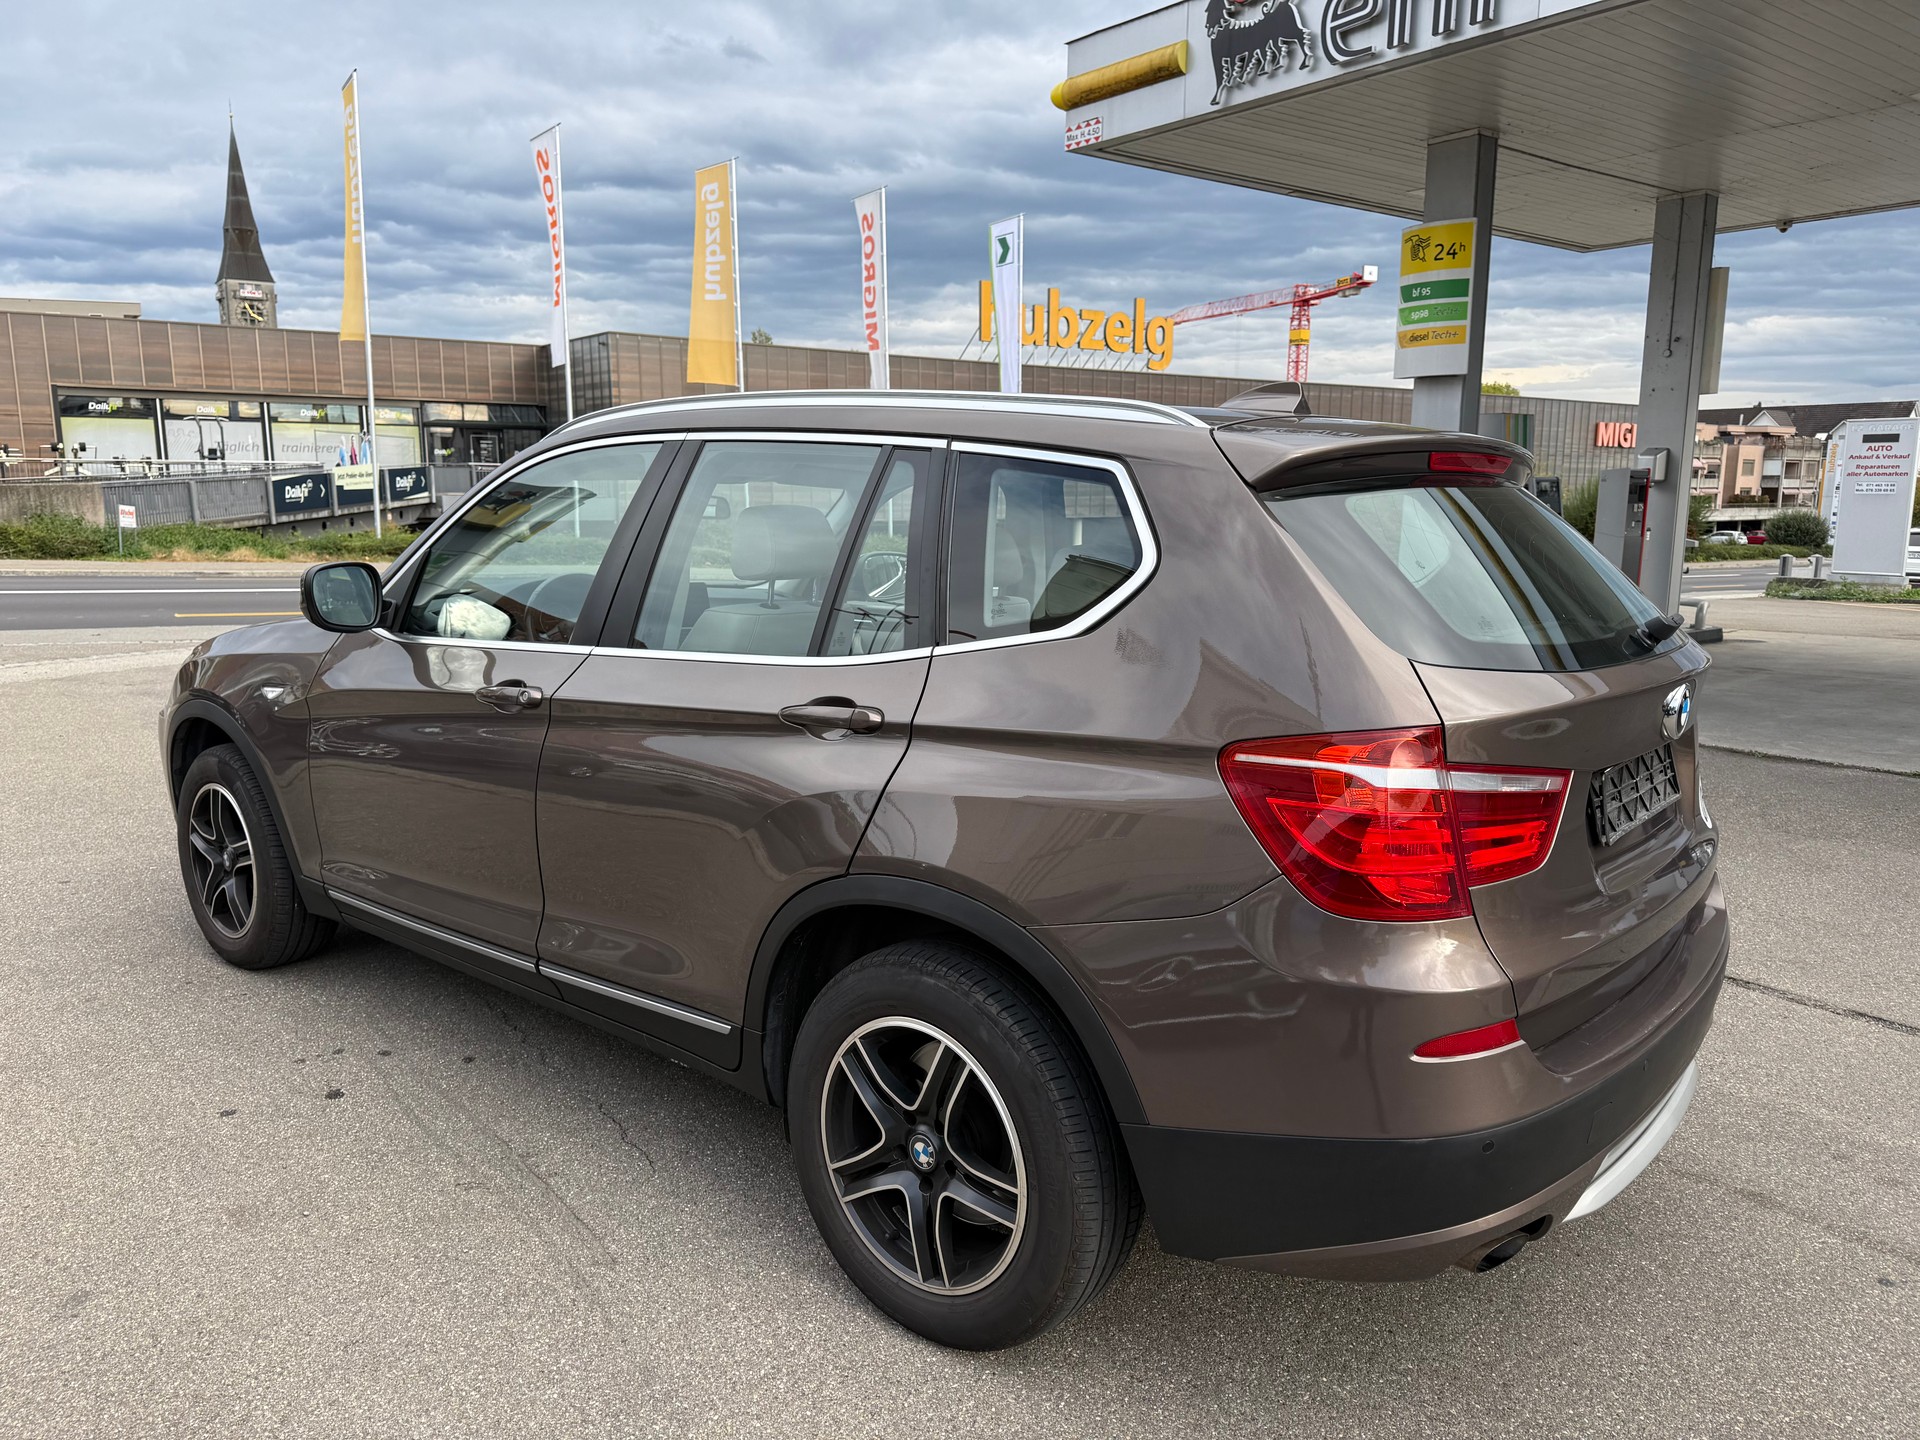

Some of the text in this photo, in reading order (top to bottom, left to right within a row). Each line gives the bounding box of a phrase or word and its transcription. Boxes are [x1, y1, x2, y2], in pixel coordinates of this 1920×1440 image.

[1412, 287, 1431, 298] bf 95
[1408, 331, 1430, 342] diesel
[214, 441, 260, 454] äglich
